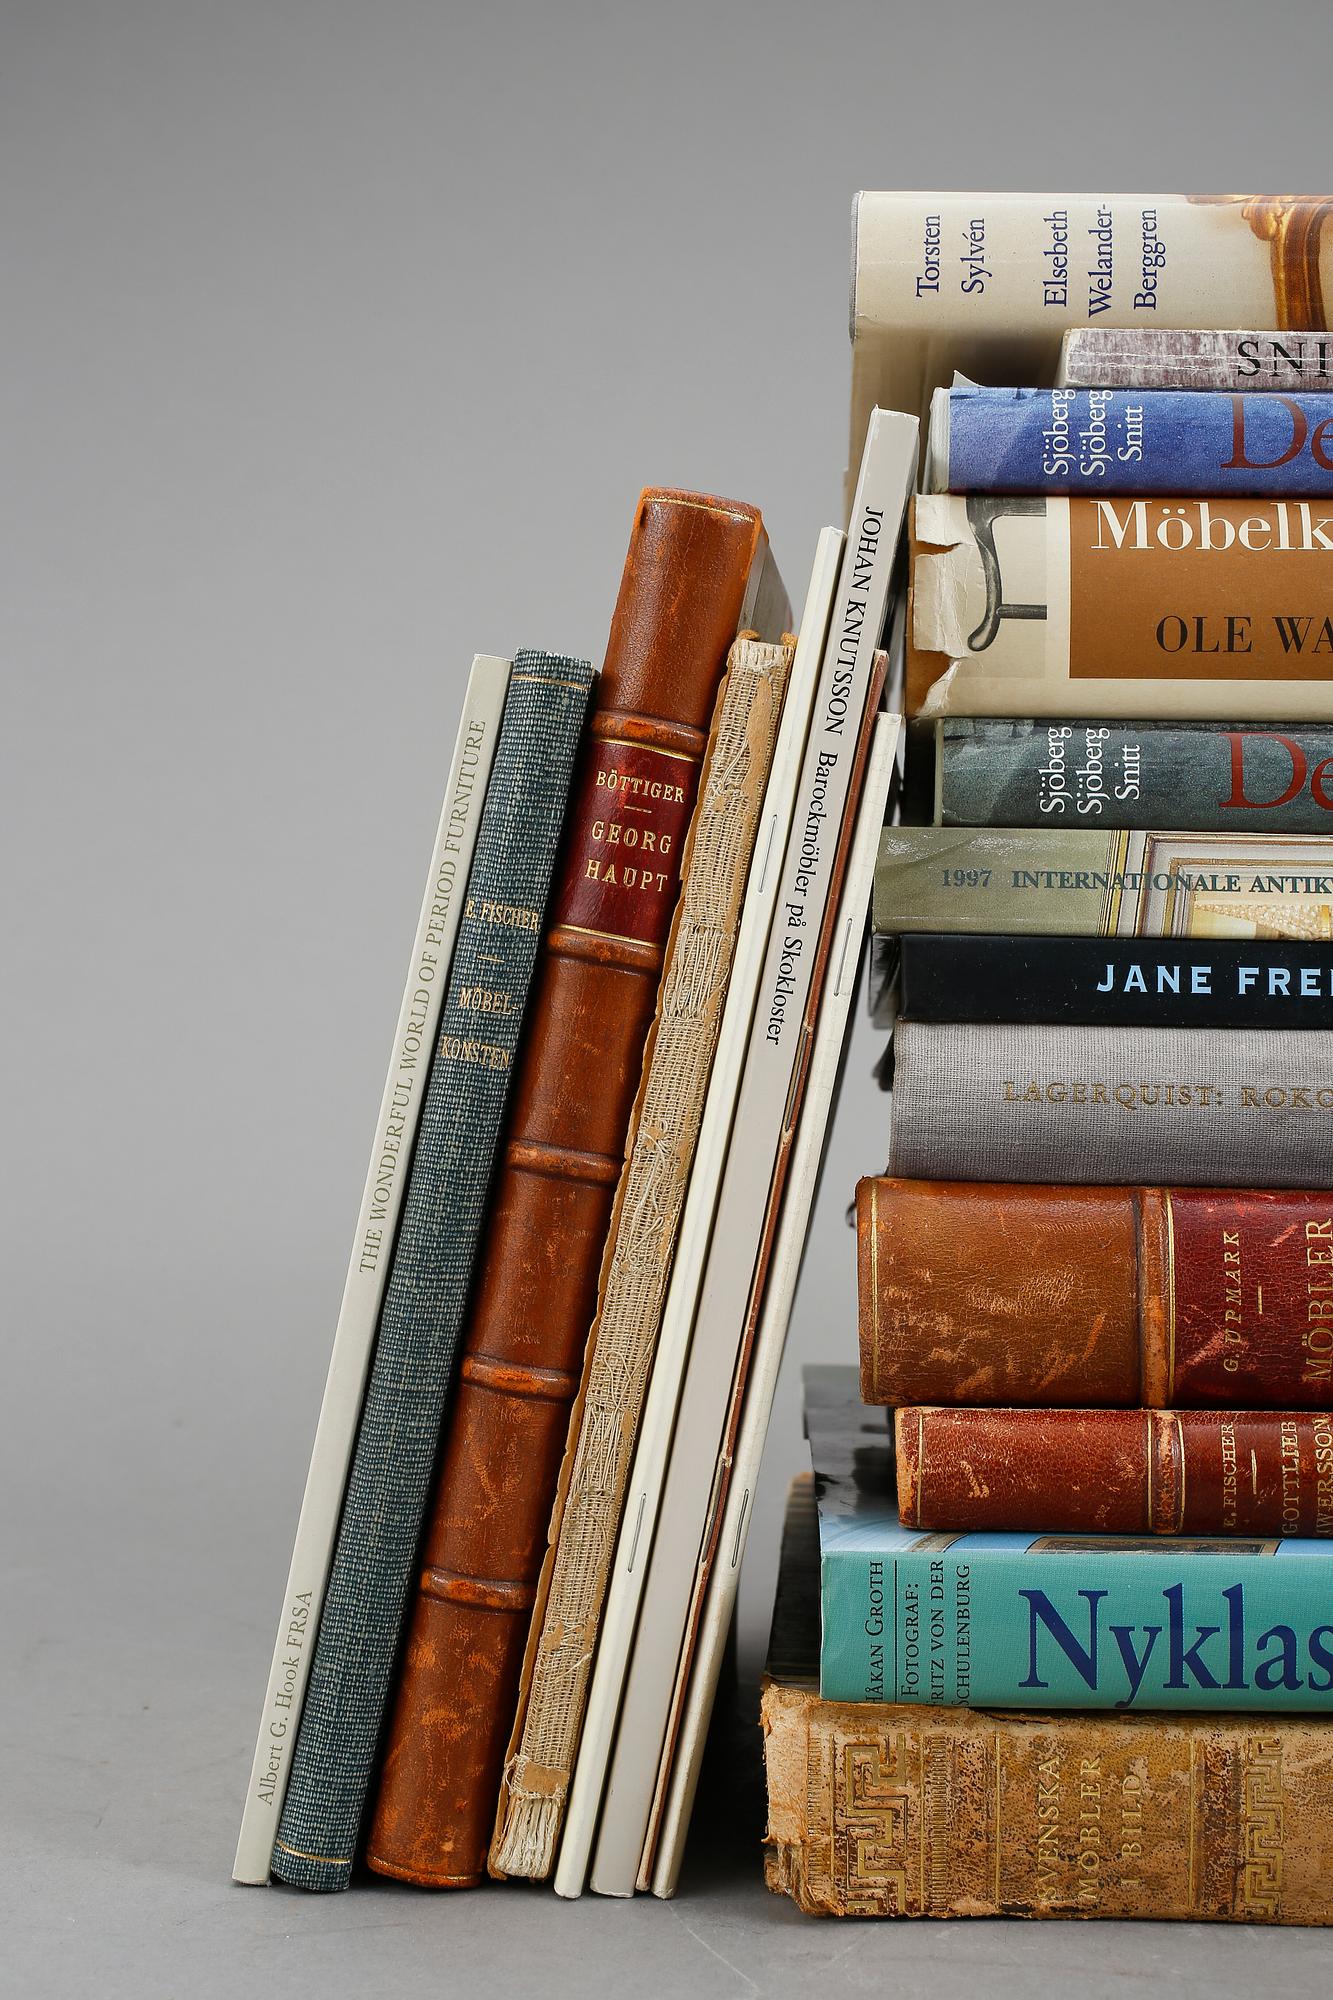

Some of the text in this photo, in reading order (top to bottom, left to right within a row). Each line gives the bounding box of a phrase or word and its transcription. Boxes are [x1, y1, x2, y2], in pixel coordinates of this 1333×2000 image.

[916, 214, 940, 298] Torsten
[960, 218, 992, 294] Sylvén
[1043, 210, 1068, 307] Elsebeth
[1088, 203, 1113, 318] Welander-
[1133, 209, 1166, 310] Berggren
[1237, 340, 1331, 377] SNI
[1042, 389, 1076, 475] Sjöberg
[1079, 390, 1113, 476] Sjöberg
[1117, 405, 1143, 461] Snitt
[1090, 501, 1333, 550] Möbelk
[1156, 615, 1253, 652] OLE
[596, 769, 684, 804] BÖTTIGER
[766, 506, 884, 1046] JOHAN KNUTSSON Barockmöbler på Skokloster
[1038, 727, 1073, 813] Sjöberg
[1076, 728, 1110, 814] Sjöberg
[1114, 744, 1140, 800] Snitt
[585, 859, 668, 892] HAUPT
[592, 821, 672, 854] GEORG
[942, 867, 1333, 893] 1997 INTERNATIONALE ANTIK
[465, 899, 539, 933] E. FISCHER
[359, 720, 486, 1272] THE WONDERFUL WORLD OF PERIOD FURNITURE
[459, 986, 519, 1016] MÖBEL-
[1097, 964, 1333, 997] JANE FRE
[441, 1035, 511, 1069] KONSTEN
[1002, 1081, 1222, 1110] LAGERQUIST:
[1223, 1231, 1242, 1372] G. UPMARK
[1302, 1218, 1333, 1381] MÖBLER
[1221, 1421, 1237, 1508] FISCHER
[1281, 1421, 1300, 1534] GOTTLIEB
[865, 1561, 884, 1636] GROTH
[901, 1584, 919, 1696] FOTOGRAF:
[927, 1560, 944, 1705] RITZ VON DER
[1018, 1583, 1333, 1708] Nyklas
[257, 1591, 313, 1806] Albert G. Hook FRSA
[1037, 1756, 1060, 1900] SVENSKA
[1121, 1774, 1142, 1885] I BILD
